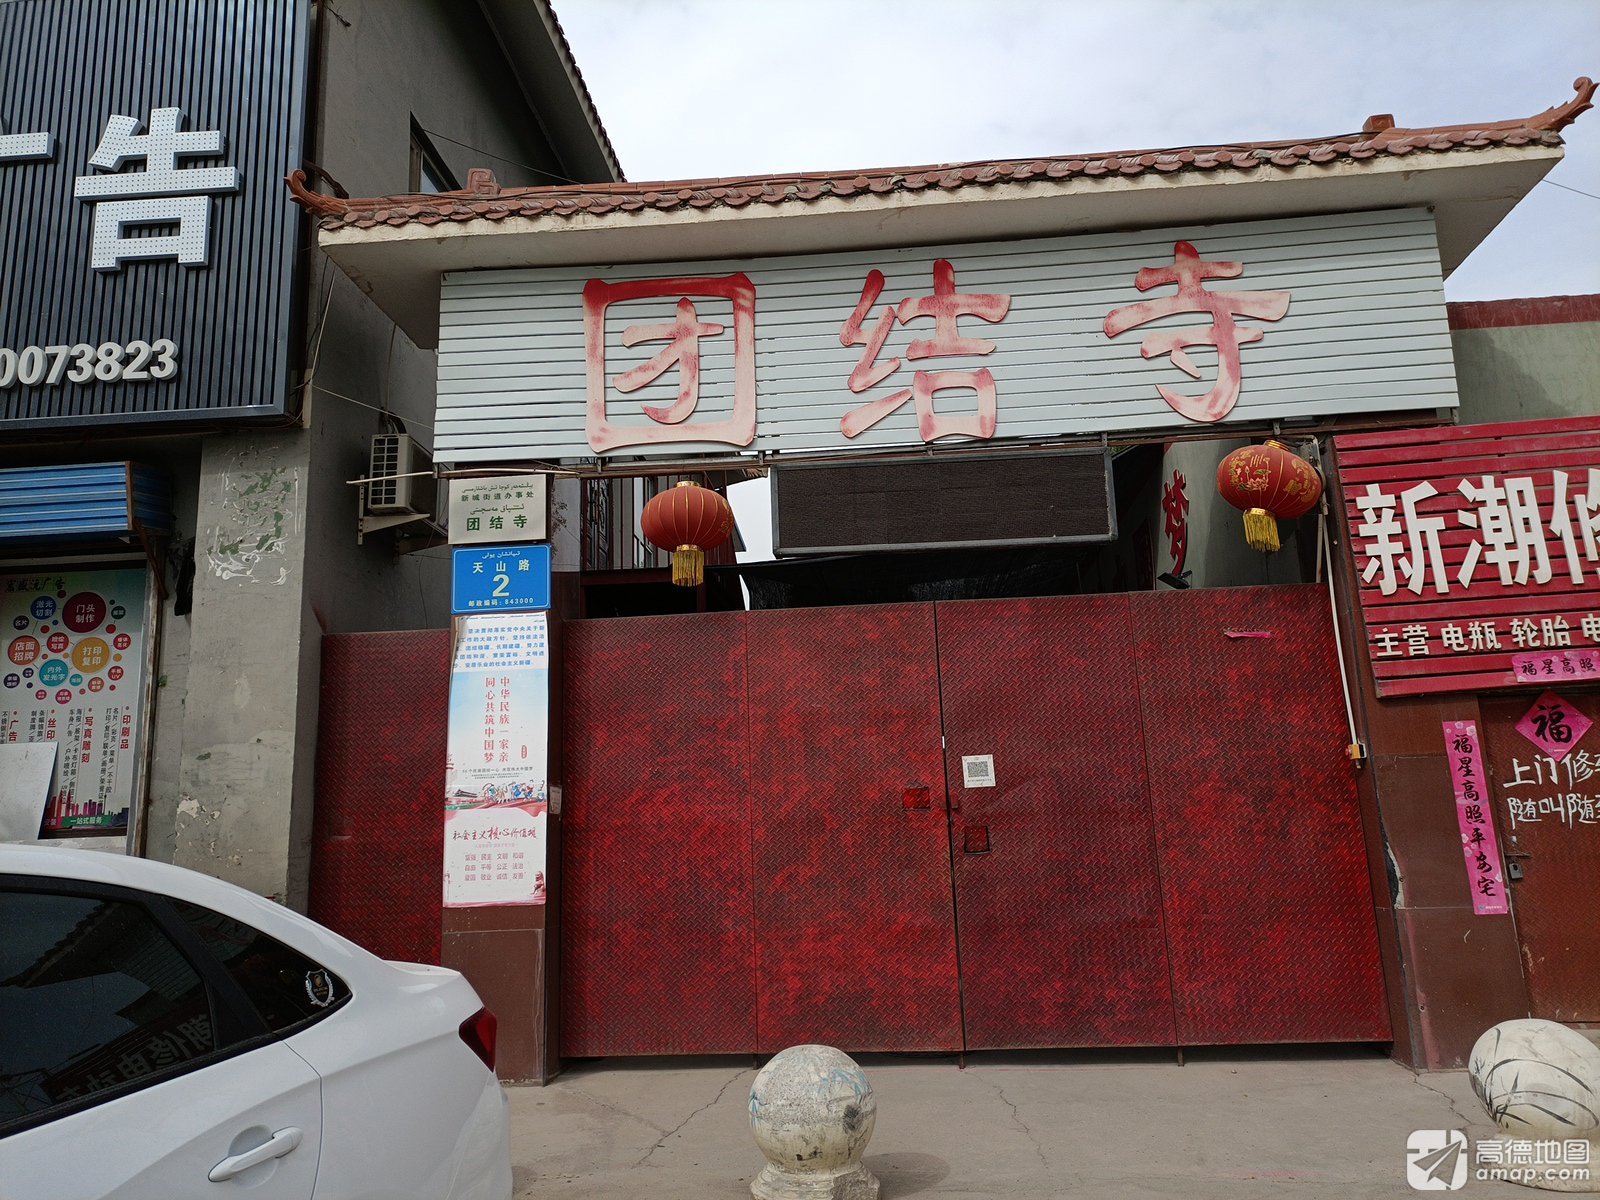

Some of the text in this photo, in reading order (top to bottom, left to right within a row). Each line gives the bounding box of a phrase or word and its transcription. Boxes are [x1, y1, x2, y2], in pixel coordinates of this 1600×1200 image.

[582, 240, 1291, 453] 团结寺
[0, 339, 178, 389] 0073823
[461, 491, 534, 502] 新城街道办事处
[466, 514, 528, 531] 团结寺
[472, 559, 530, 574] 天山路
[492, 574, 510, 597] 2
[35, 608, 53, 617] 切割
[36, 600, 53, 608] 激光
[76, 604, 95, 613] 门头
[75, 614, 95, 623] 制作
[15, 641, 36, 651] 店面
[1374, 624, 1430, 657] 主营
[1441, 621, 1502, 652] 电瓶
[1510, 615, 1571, 648] 轮胎
[13, 652, 34, 661] 招牌
[82, 657, 101, 665] 复印
[83, 646, 102, 655] 打印
[1520, 656, 1598, 676] 福星高照
[9, 719, 19, 741] 广告
[46, 718, 57, 740] 丝印
[484, 677, 496, 763] 同心共筑中国梦
[499, 676, 510, 763] 中华民族一家亲
[1530, 704, 1573, 744] 福
[81, 716, 94, 763] 写真雕刻
[120, 714, 131, 749] 印刷品
[1503, 750, 1600, 790] 上门修
[70, 816, 103, 825] 一站式服务
[1452, 733, 1496, 897] 福星高照平安宅
[1507, 793, 1600, 830] 随叫随
[452, 826, 538, 841] 社会主义核心价值观
